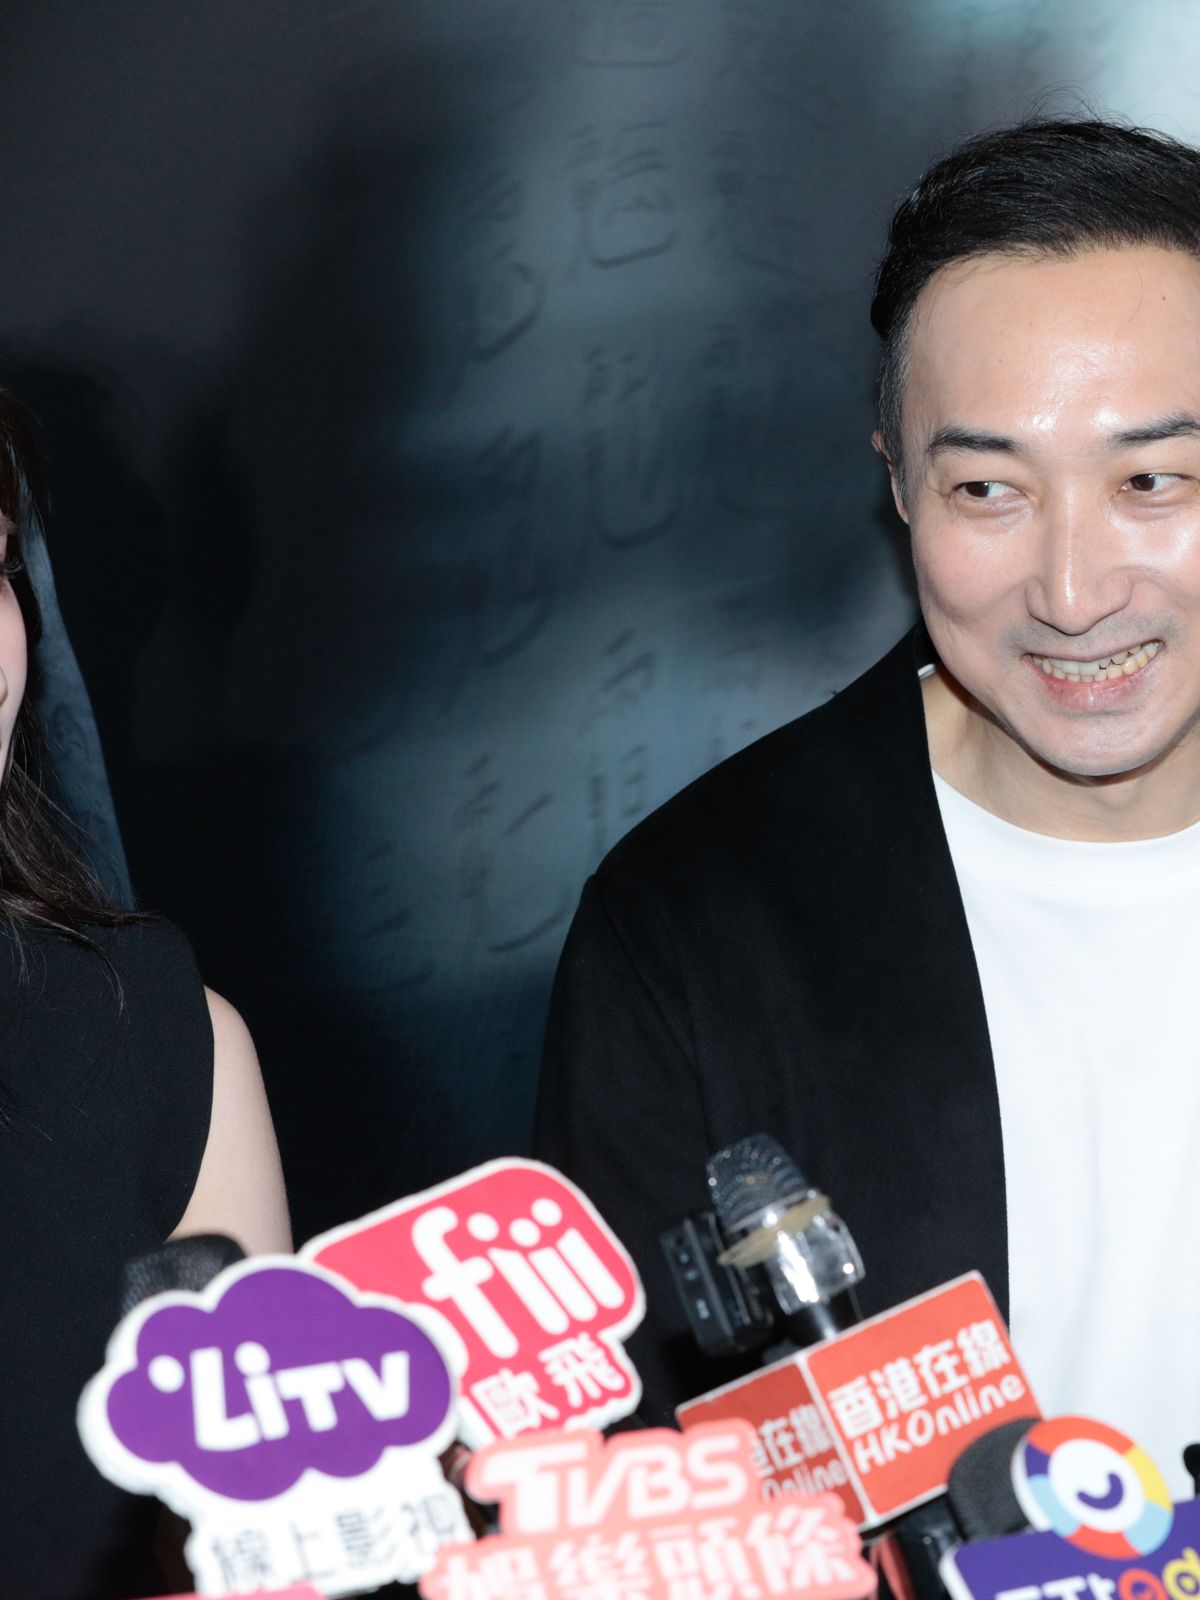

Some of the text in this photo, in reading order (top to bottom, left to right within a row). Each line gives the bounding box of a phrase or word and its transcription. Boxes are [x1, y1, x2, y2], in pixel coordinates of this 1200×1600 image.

[469, 1331, 627, 1440] 歐飛
[827, 1319, 1012, 1440] 香港在線
[853, 1374, 1026, 1473] HKOnline
[482, 1434, 750, 1534] TVBS
